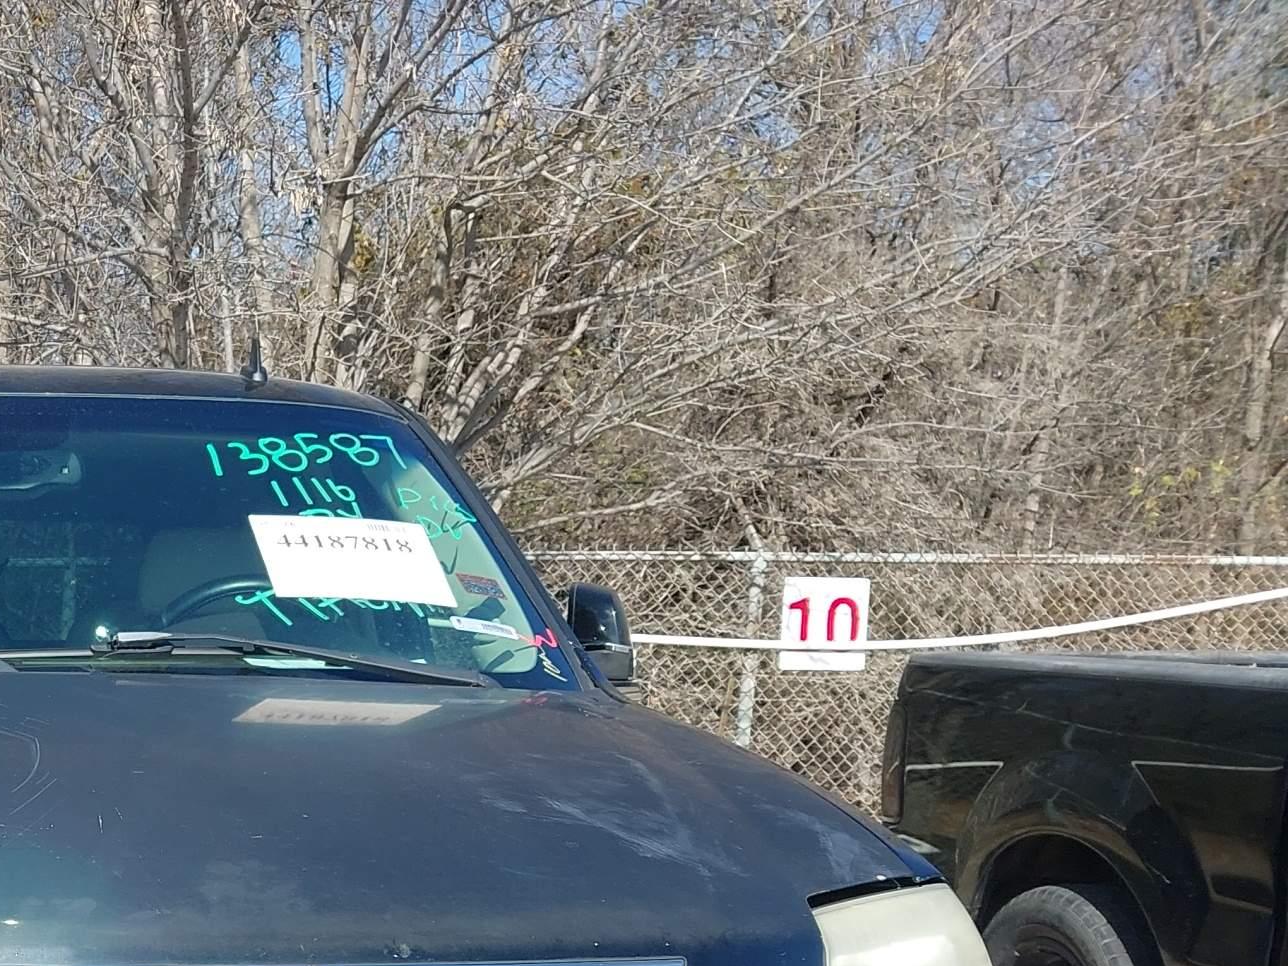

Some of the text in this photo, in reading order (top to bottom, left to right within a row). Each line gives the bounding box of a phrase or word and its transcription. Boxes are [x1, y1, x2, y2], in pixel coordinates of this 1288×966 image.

[206, 433, 407, 476] 138587
[277, 533, 413, 552] 44187818
[789, 597, 860, 641] 10
